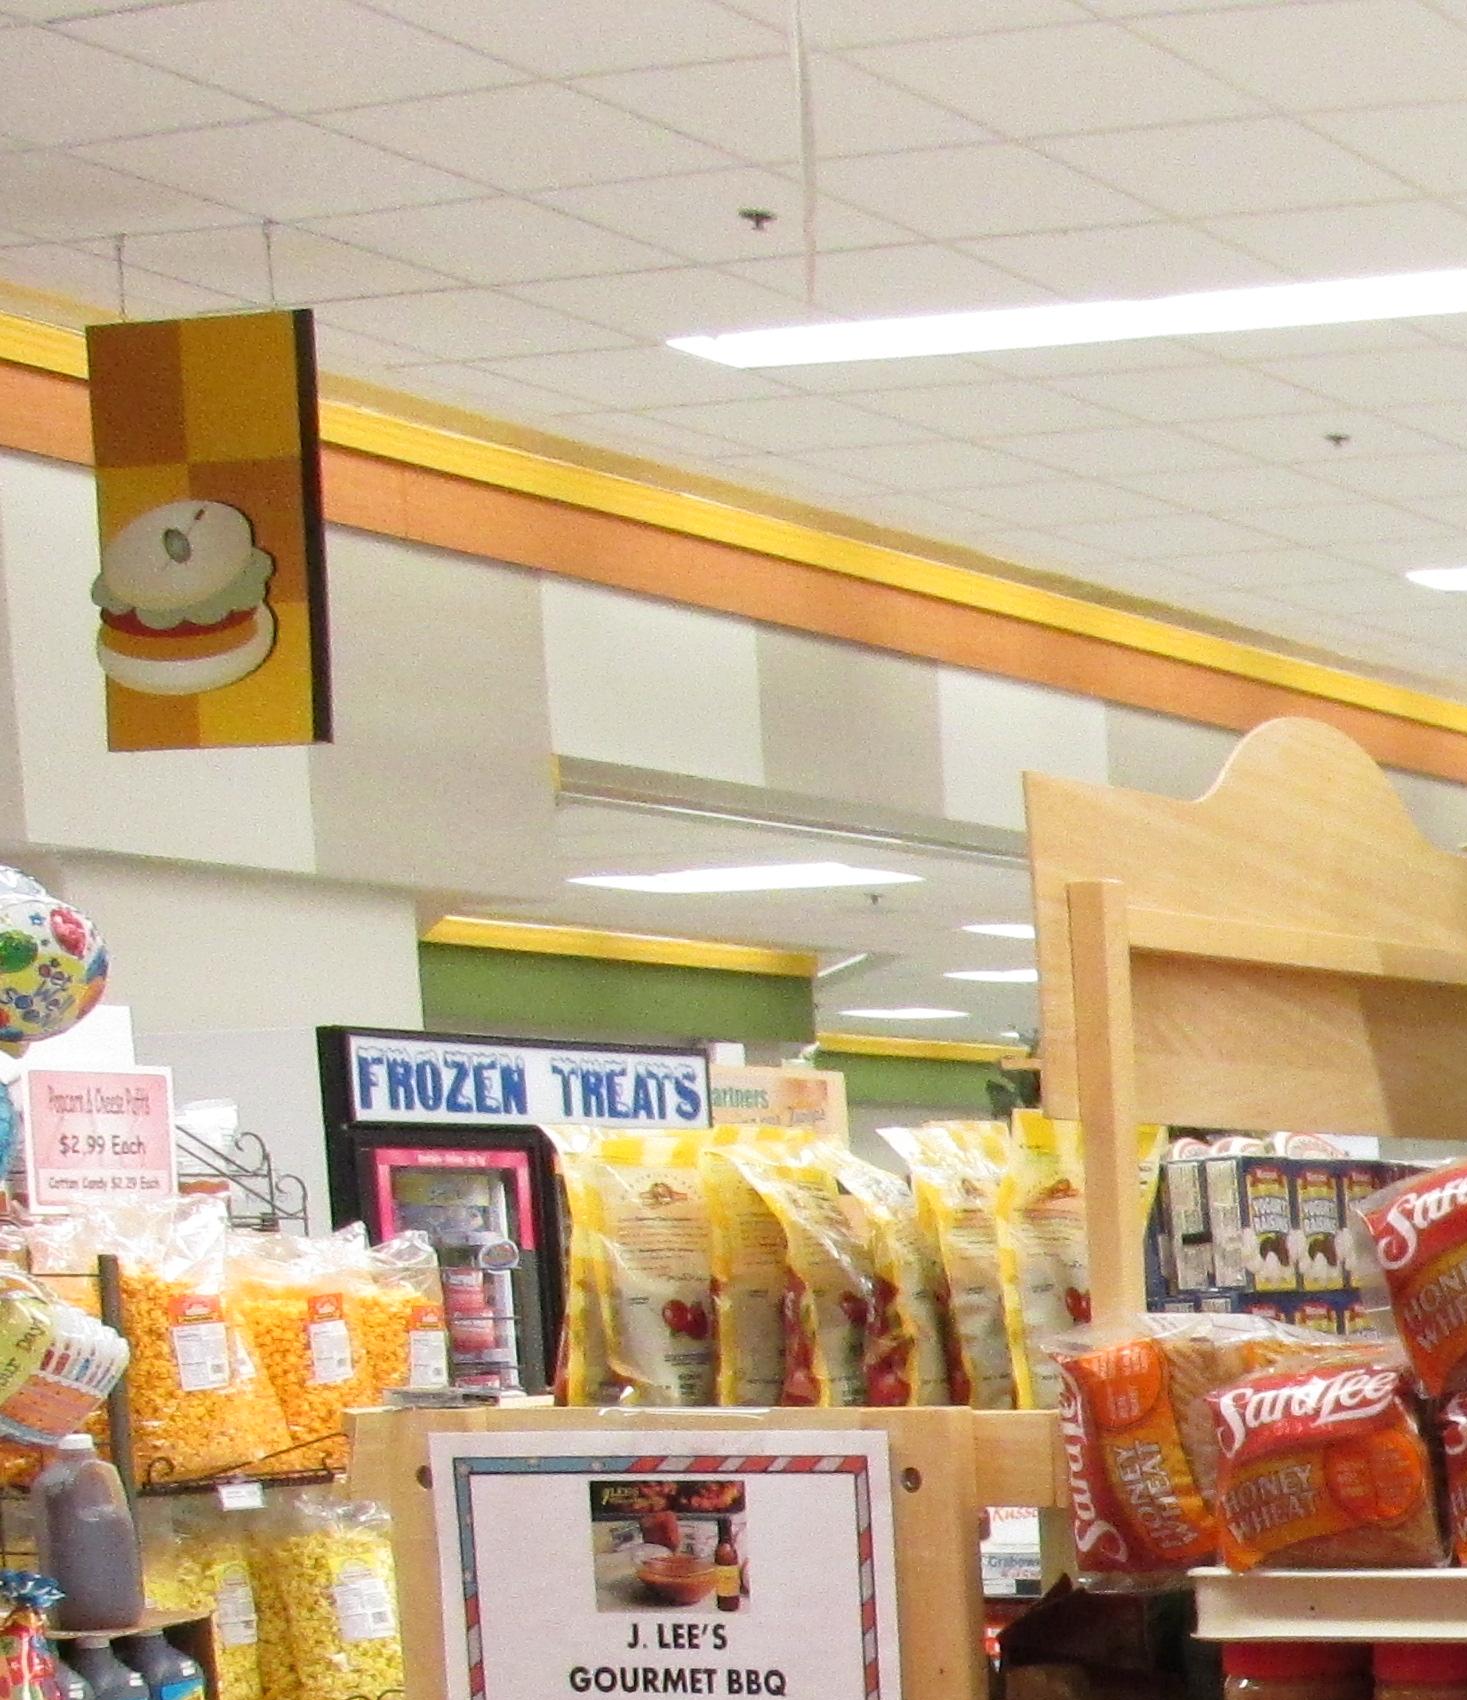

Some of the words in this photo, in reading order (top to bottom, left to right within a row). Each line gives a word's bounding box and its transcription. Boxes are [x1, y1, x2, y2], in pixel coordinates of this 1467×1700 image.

[357, 1046, 528, 1116] FROZEN
[551, 1057, 702, 1120] TREATS
[60, 1134, 105, 1157] $2.99
[112, 1135, 146, 1156] Each
[1217, 1377, 1320, 1457] Sara
[1315, 1366, 1399, 1427] Lee
[627, 1623, 649, 1650] J.
[656, 1622, 729, 1650] LEE'S
[568, 1665, 718, 1696] GOURMET
[727, 1669, 788, 1698] BBQ
